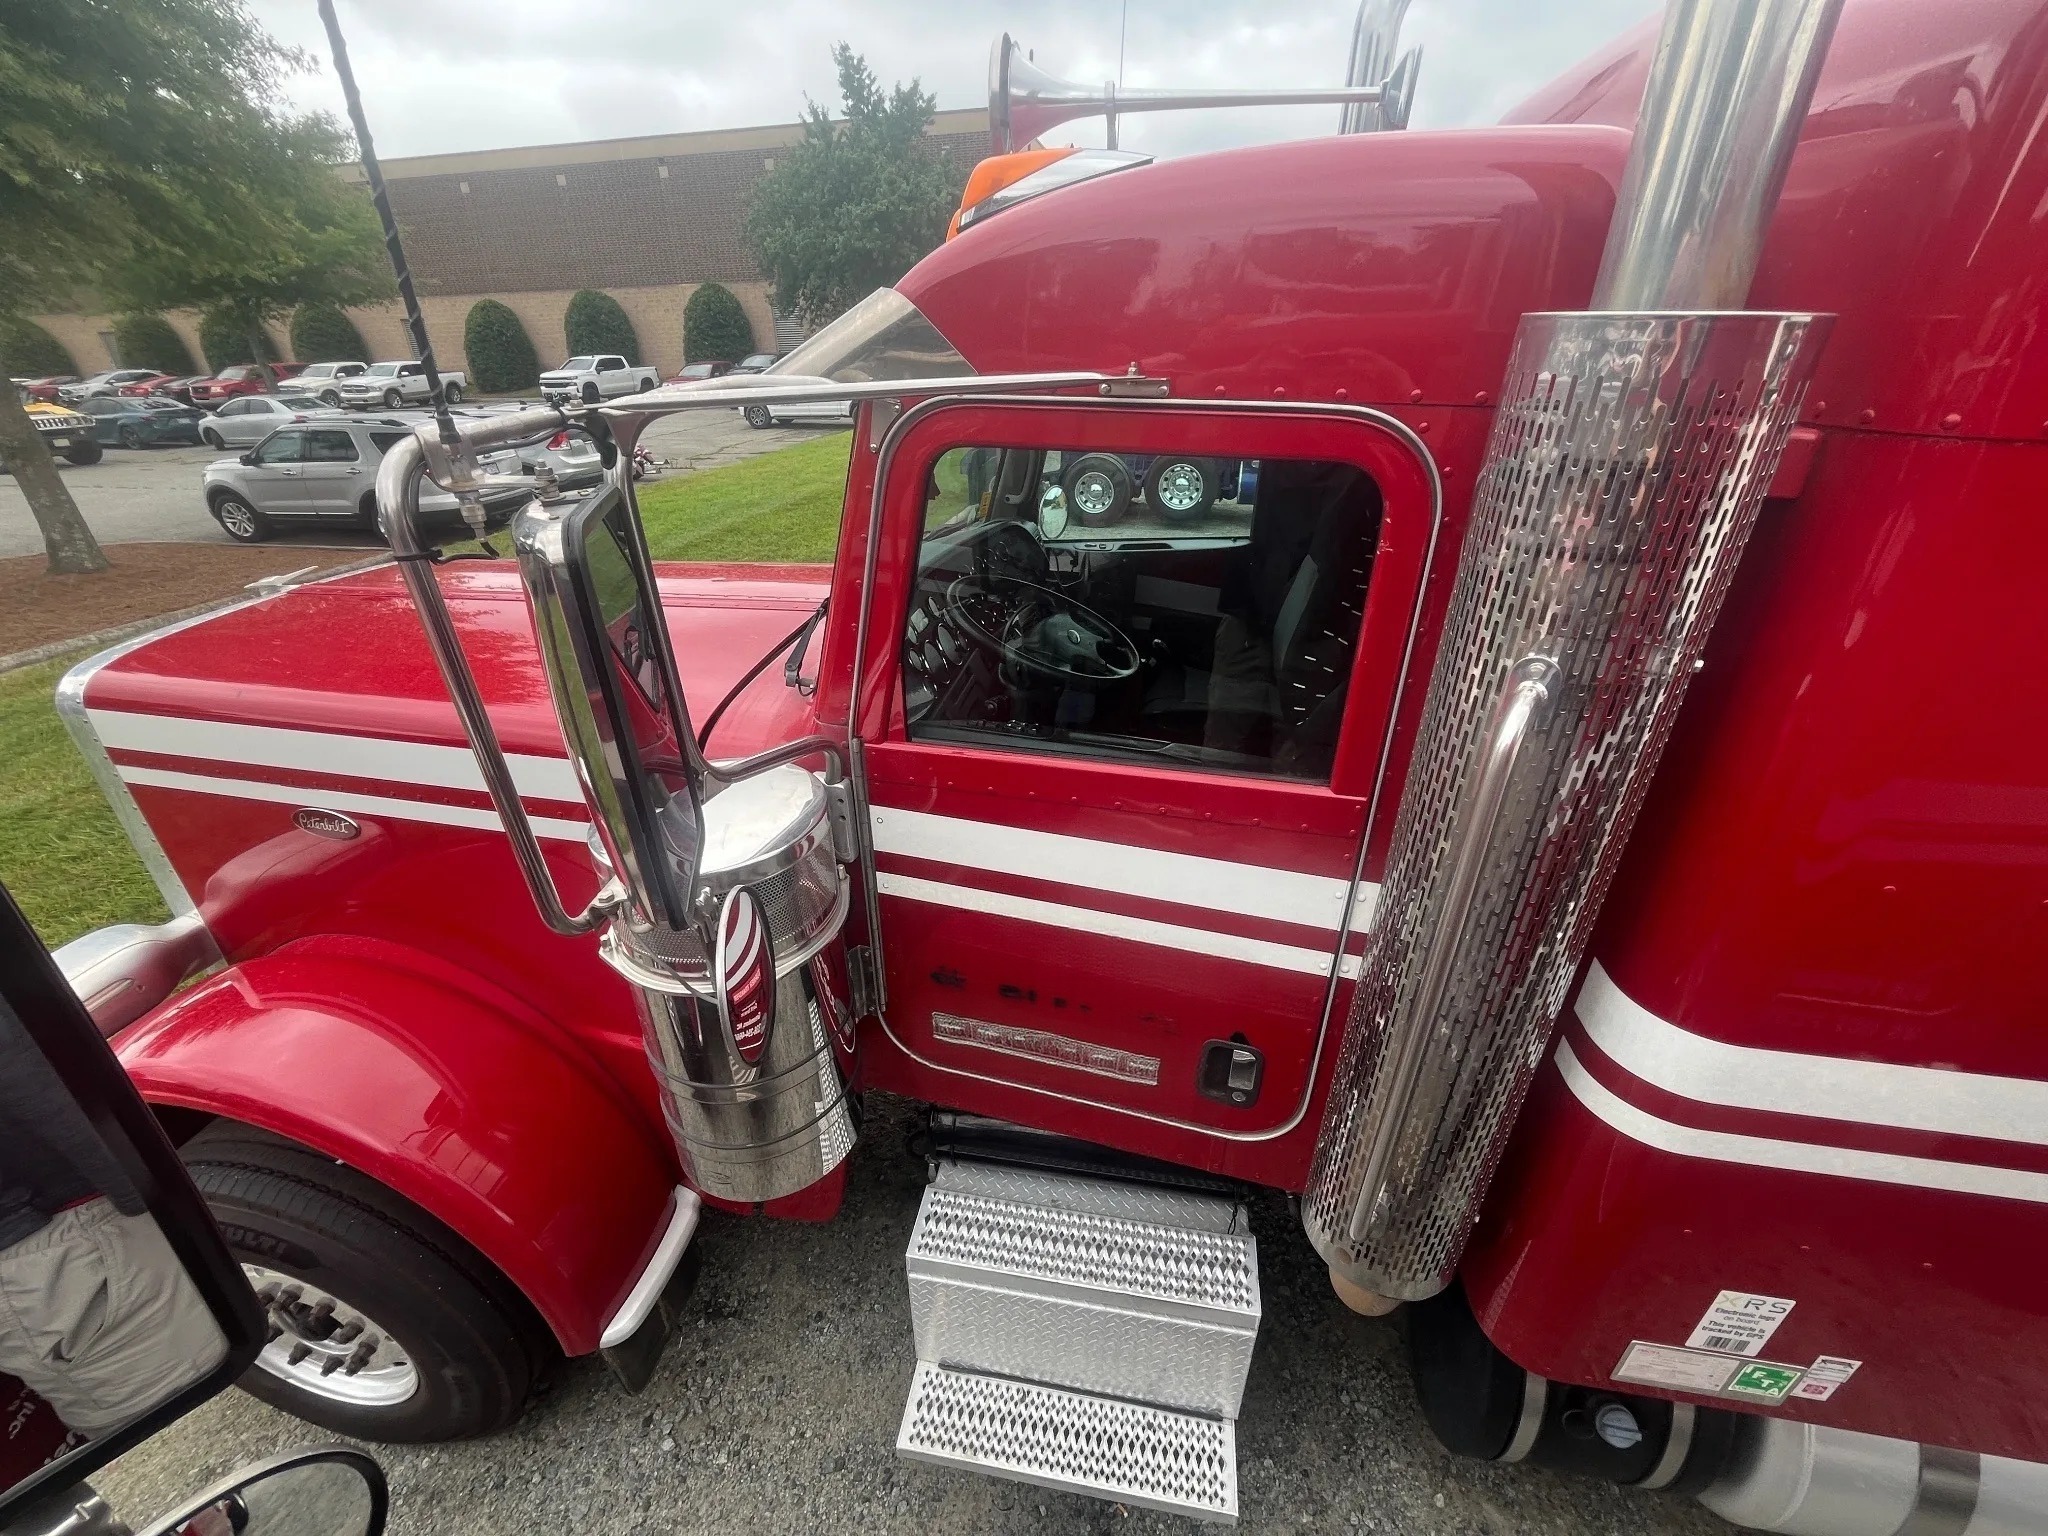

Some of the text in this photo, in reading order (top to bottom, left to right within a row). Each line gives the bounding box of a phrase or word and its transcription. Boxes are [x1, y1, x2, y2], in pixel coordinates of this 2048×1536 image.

[299, 812, 350, 834] Peterbilt
[217, 1224, 287, 1254] ULTI
[1716, 1294, 1789, 1313] XRS
[1715, 1307, 1756, 1318] Electronic
[1736, 1317, 1760, 1325] board
[1702, 1325, 1732, 1334] tracked
[1727, 1324, 1757, 1332] vehicle
